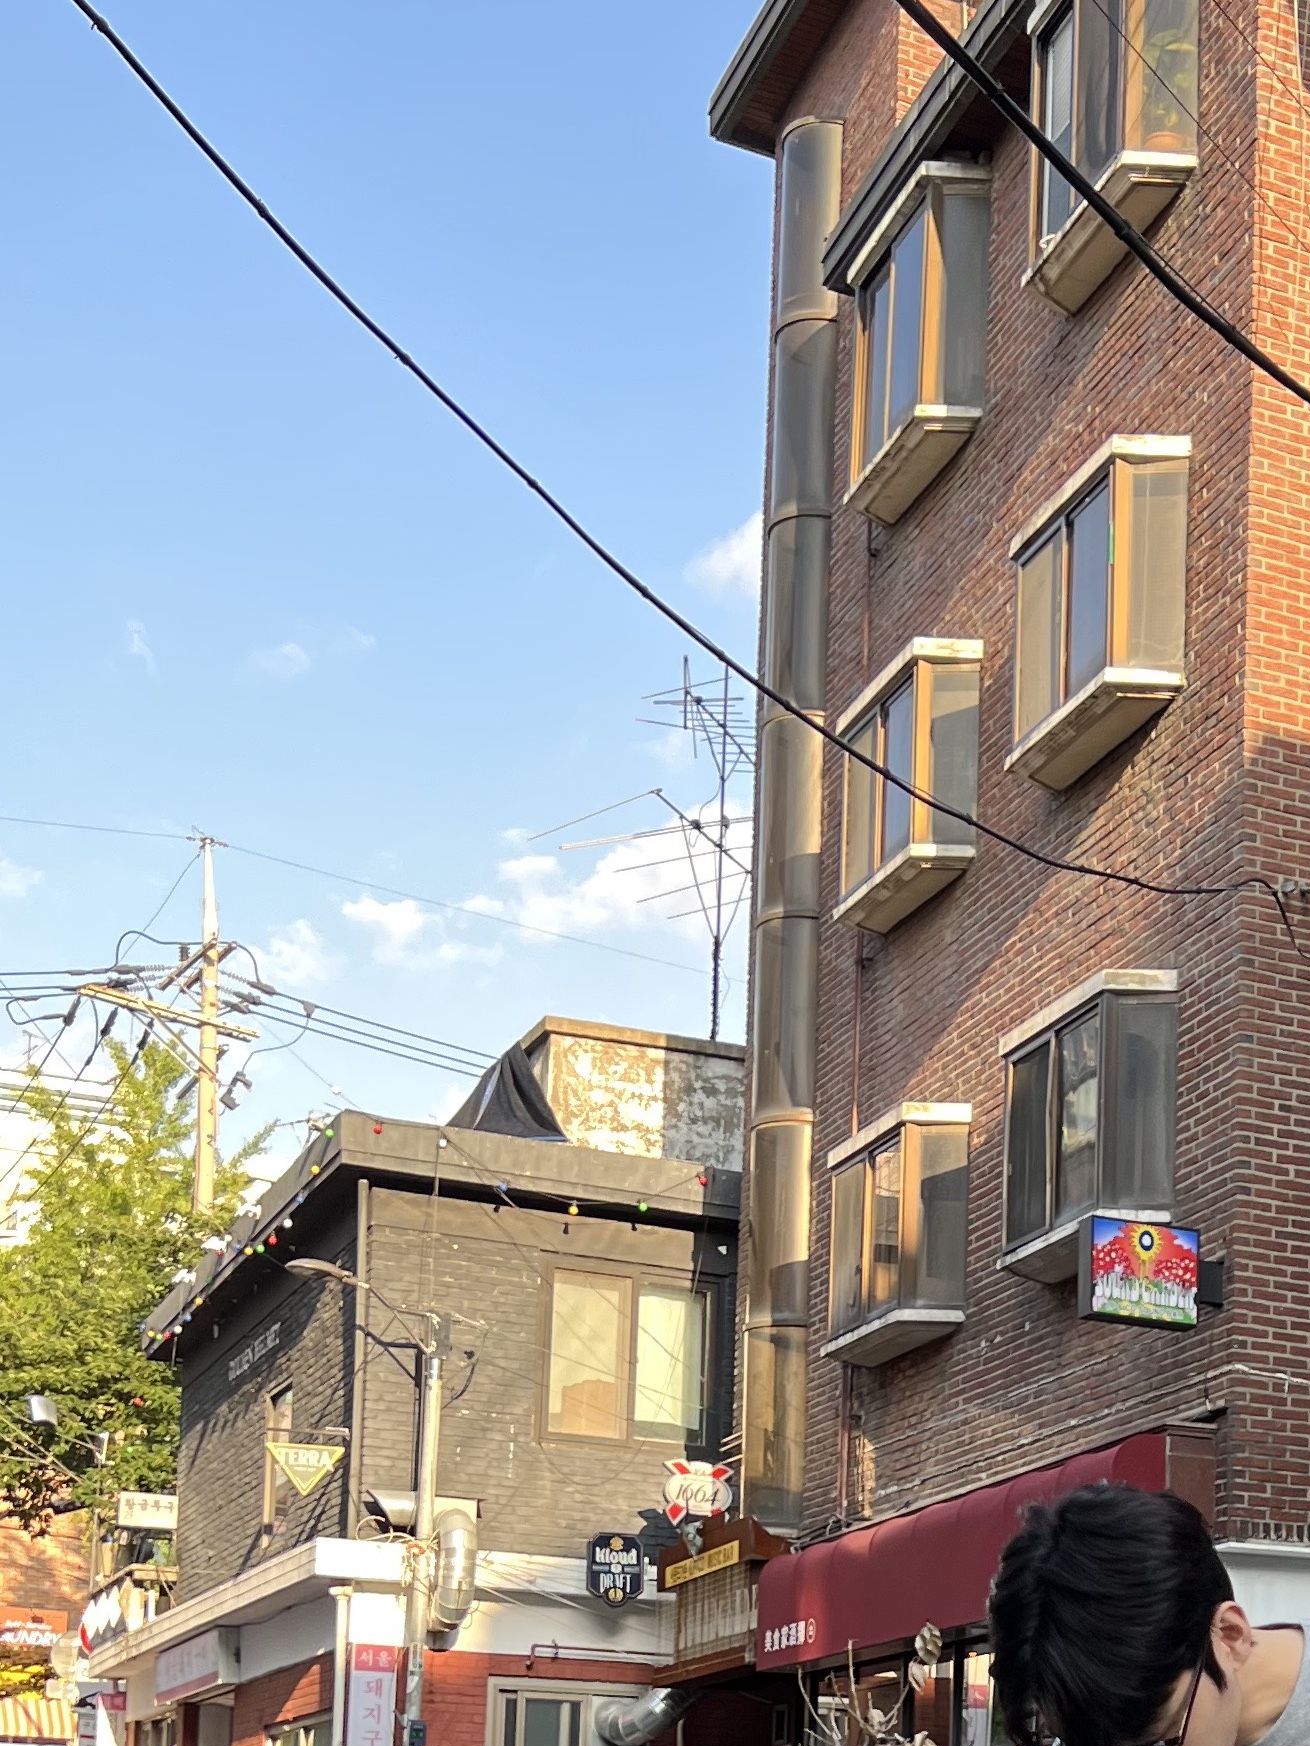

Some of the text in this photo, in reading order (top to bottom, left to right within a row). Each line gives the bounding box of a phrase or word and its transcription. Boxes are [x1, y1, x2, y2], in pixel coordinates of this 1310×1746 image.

[276, 1447, 334, 1471] TERRA
[676, 1483, 720, 1506] 1664
[595, 1546, 637, 1565] Kloud
[600, 1573, 631, 1593] DRAFT
[360, 1650, 391, 1668] 서울
